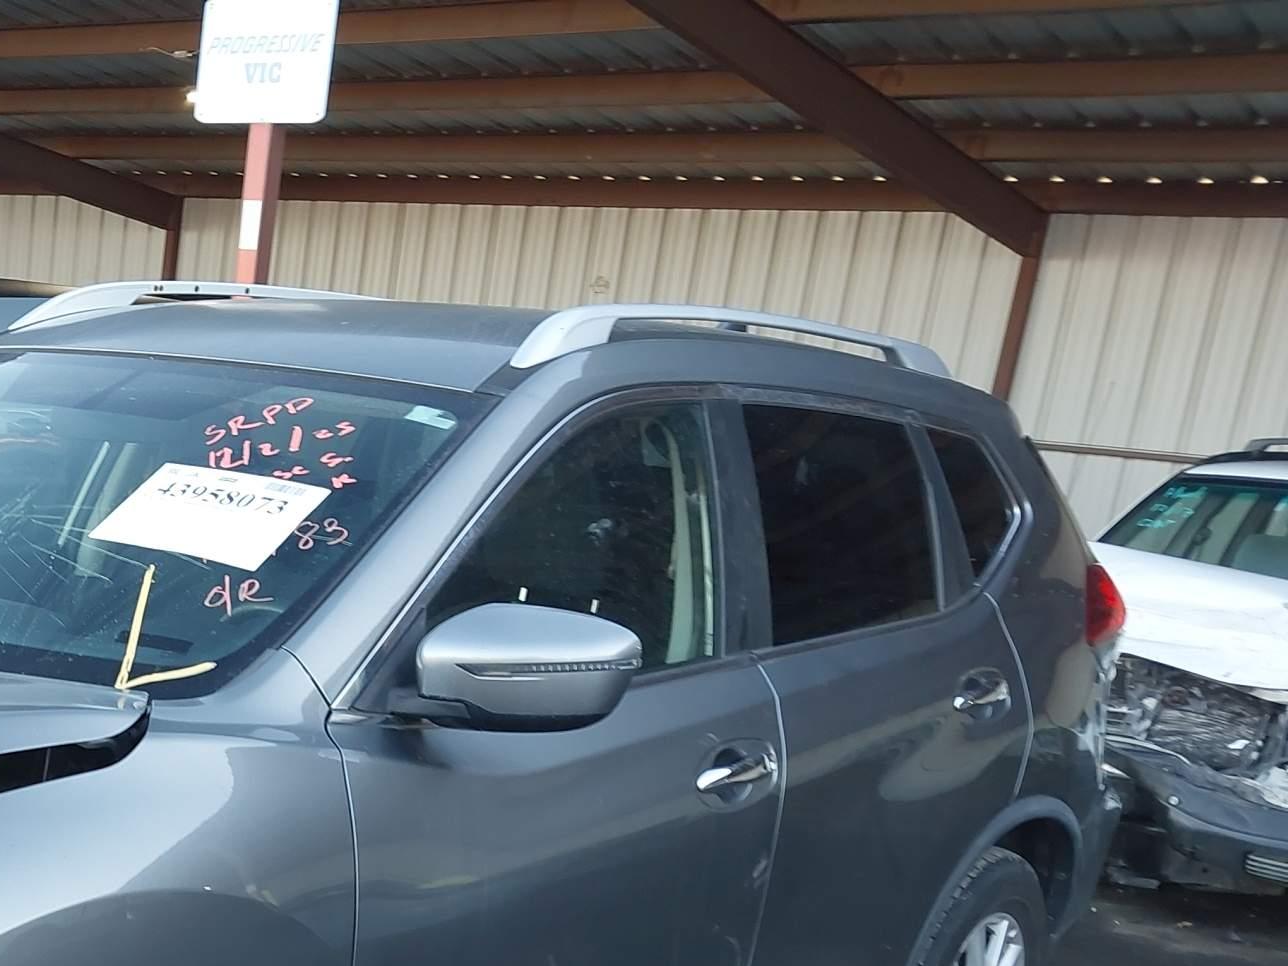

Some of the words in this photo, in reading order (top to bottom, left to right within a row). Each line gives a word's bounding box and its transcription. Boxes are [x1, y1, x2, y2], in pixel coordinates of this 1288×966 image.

[207, 33, 325, 54] PROGRESSIVE
[244, 61, 282, 83] VIC
[157, 481, 289, 515] 43958073
